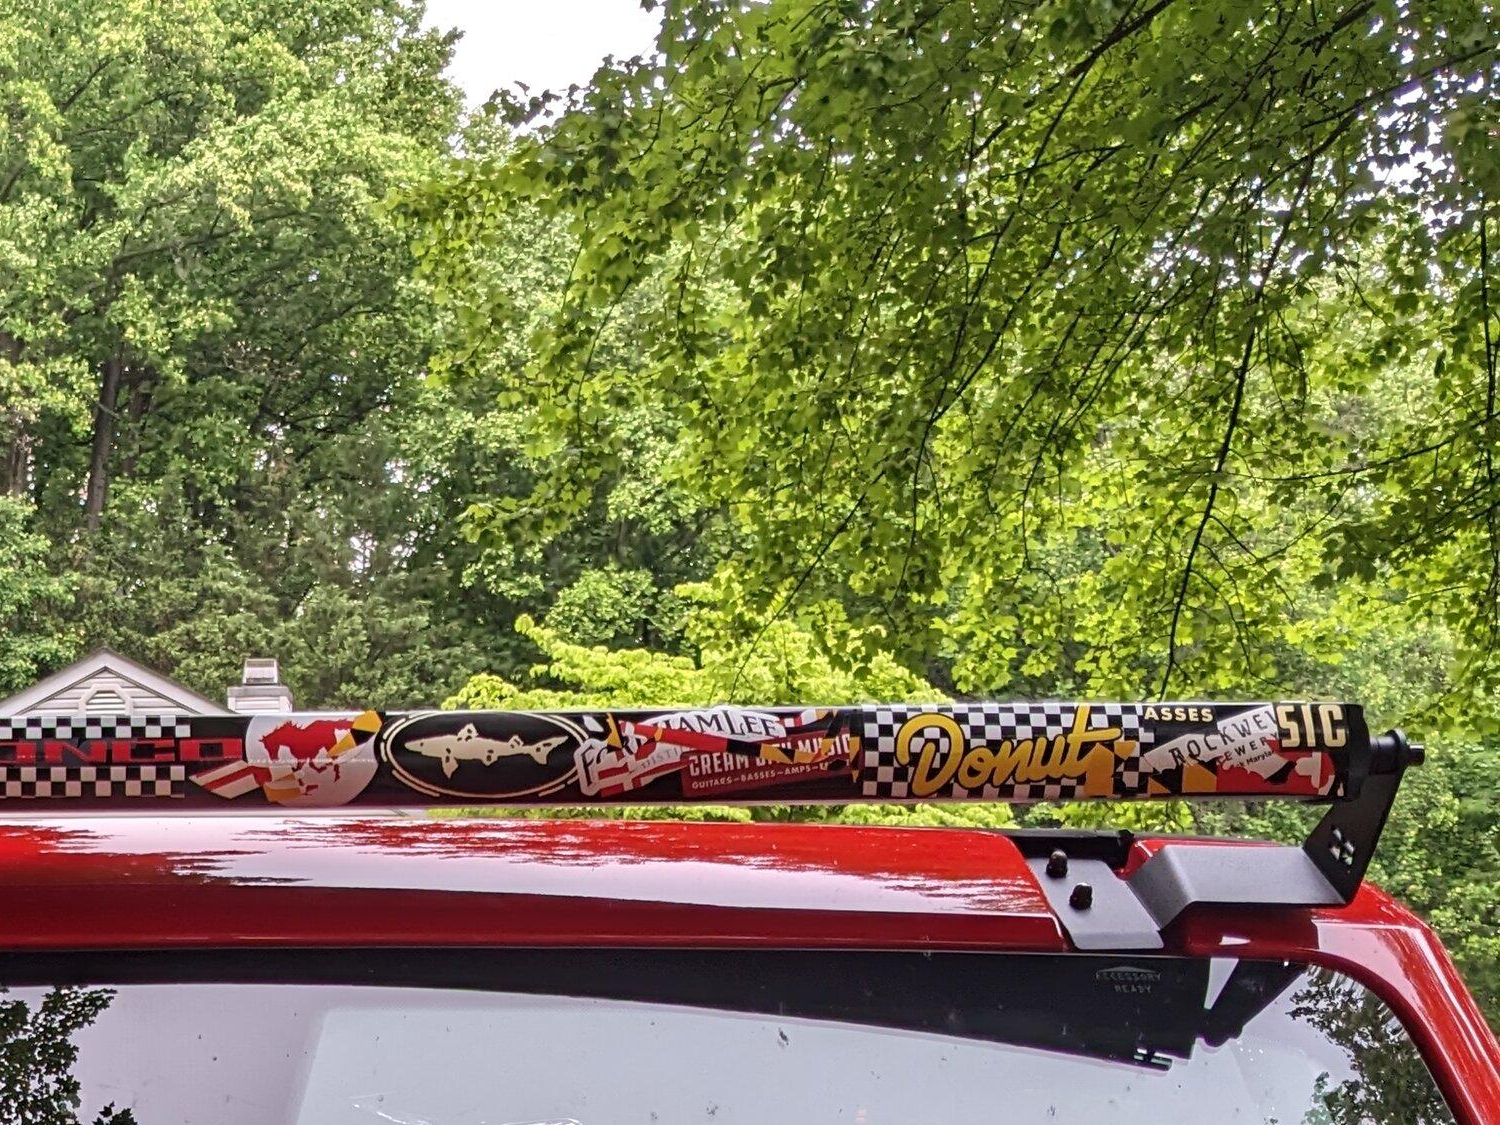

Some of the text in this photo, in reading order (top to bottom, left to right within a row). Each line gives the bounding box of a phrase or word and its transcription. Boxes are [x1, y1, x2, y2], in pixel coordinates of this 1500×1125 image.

[895, 702, 1123, 797] Donut
[688, 750, 750, 777] CREAM
[784, 764, 811, 776] AMPS
